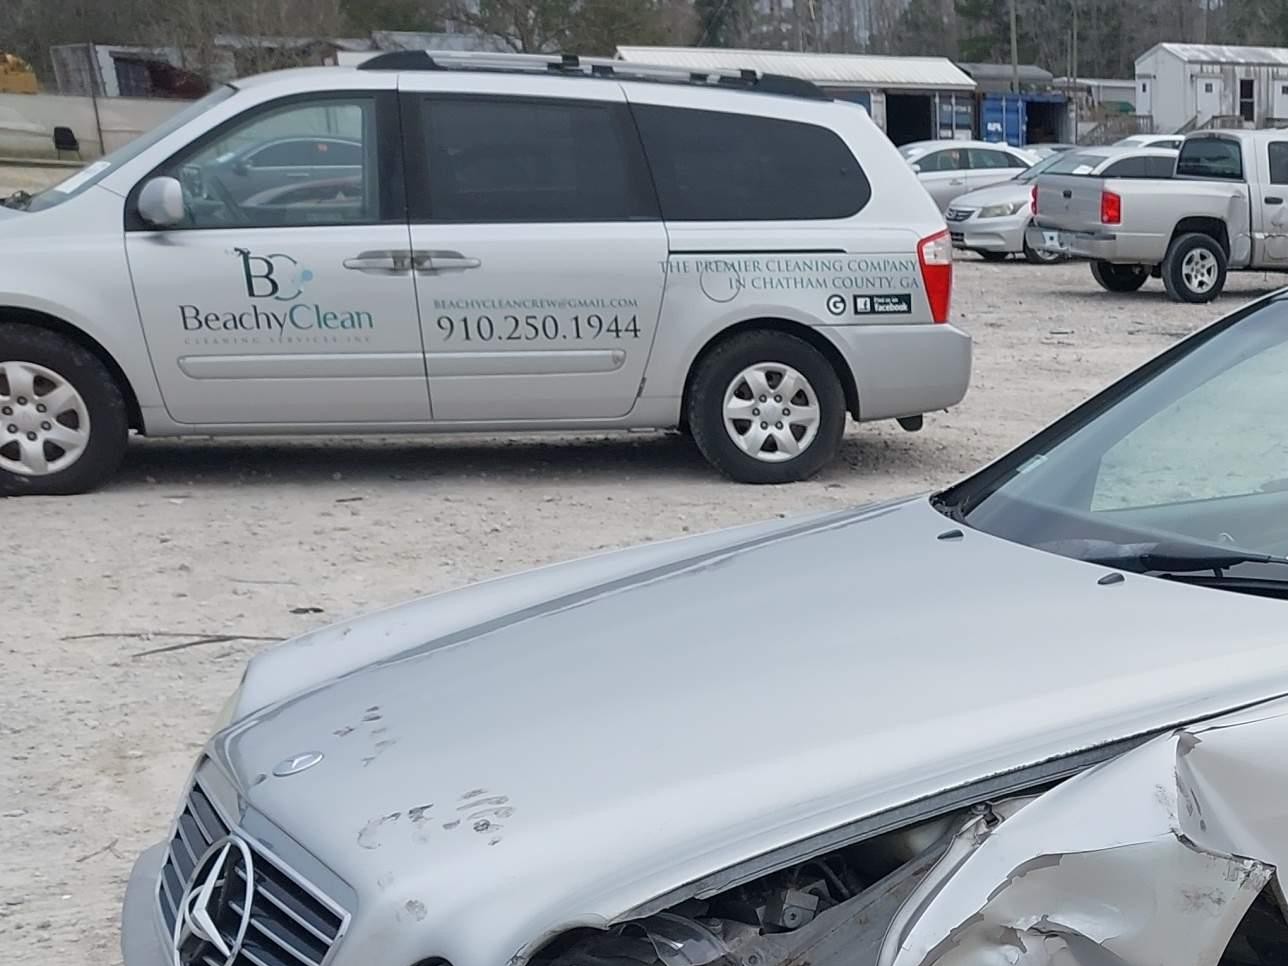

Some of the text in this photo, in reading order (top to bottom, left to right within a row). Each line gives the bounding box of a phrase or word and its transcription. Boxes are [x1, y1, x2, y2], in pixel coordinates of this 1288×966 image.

[657, 259, 918, 273] THE PREMIER CLEANING COMPANY
[728, 276, 920, 291] IN CHATHAM COUNTY, GA
[434, 298, 639, 311] BEACHYCLEANCREW@GMAIL.COM
[874, 302, 908, 312] facebook
[179, 303, 375, 338] BeachyClean
[437, 314, 641, 342] 910.250.1944
